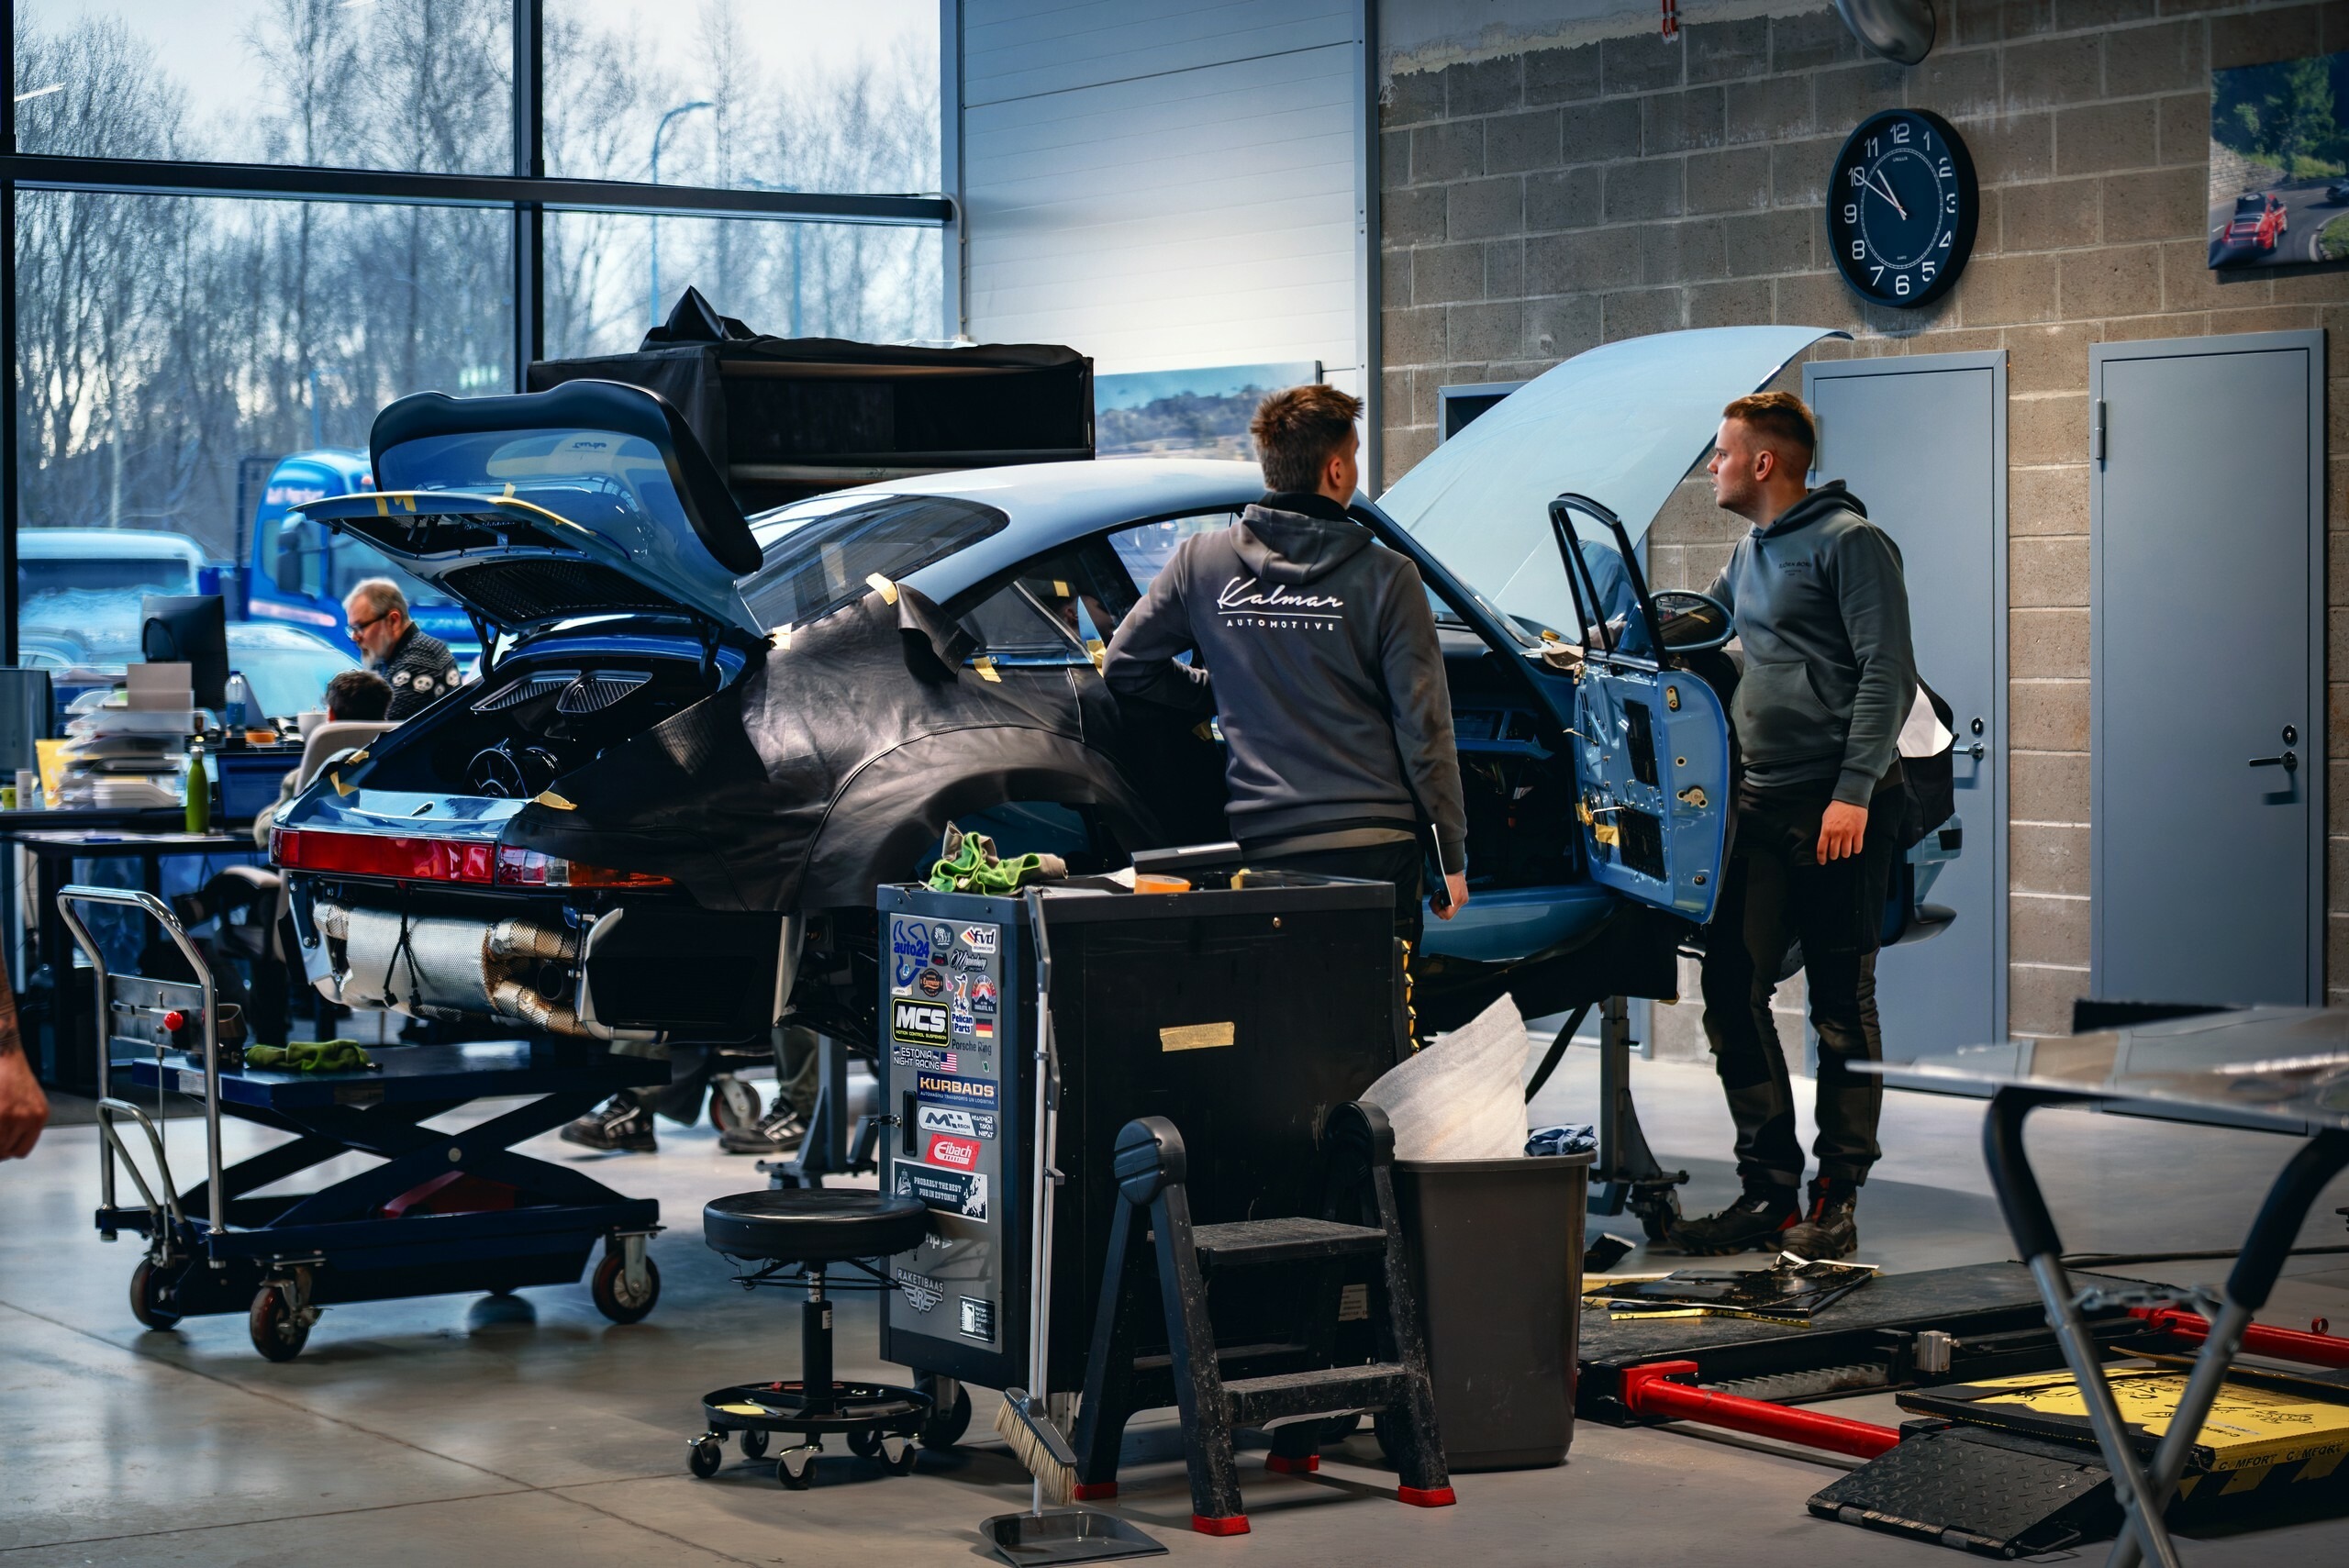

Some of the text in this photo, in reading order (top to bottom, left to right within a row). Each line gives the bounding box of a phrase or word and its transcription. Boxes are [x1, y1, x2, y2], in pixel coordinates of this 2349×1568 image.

[1889, 123, 1909, 144] 12
[1923, 131, 1931, 151] 1
[1865, 137, 1878, 158] 11
[1848, 166, 1865, 187] 10
[1939, 157, 1953, 178] 2
[1946, 193, 1955, 213] 3
[1844, 204, 1857, 224] 9
[1939, 230, 1952, 248] 4
[1852, 239, 1865, 260] 8
[1870, 266, 1884, 286] 7
[1921, 261, 1935, 282] 5
[1896, 274, 1909, 295] 6
[1217, 576, 1343, 609] Kalmar
[1226, 618, 1334, 631] AUTOMOTIVE
[974, 930, 995, 945] fvd
[894, 940, 930, 958] auto24
[896, 1005, 946, 1033] MCS
[952, 1014, 973, 1024] Pelican
[954, 1024, 971, 1033] Parts
[901, 1047, 932, 1059] ESTONIA
[952, 1039, 991, 1056] Porsche Ring
[894, 1057, 940, 1071] NIGHT RACING
[919, 1076, 995, 1098] KURBADS
[934, 1140, 972, 1162] Eibach
[913, 1176, 938, 1188] PROBABLY
[939, 1182, 948, 1190] THE
[949, 1184, 962, 1193] BEST
[918, 1187, 929, 1196] PUB
[935, 1192, 957, 1203] ESTONIA!
[897, 1269, 943, 1293] RAKETIBAAS
